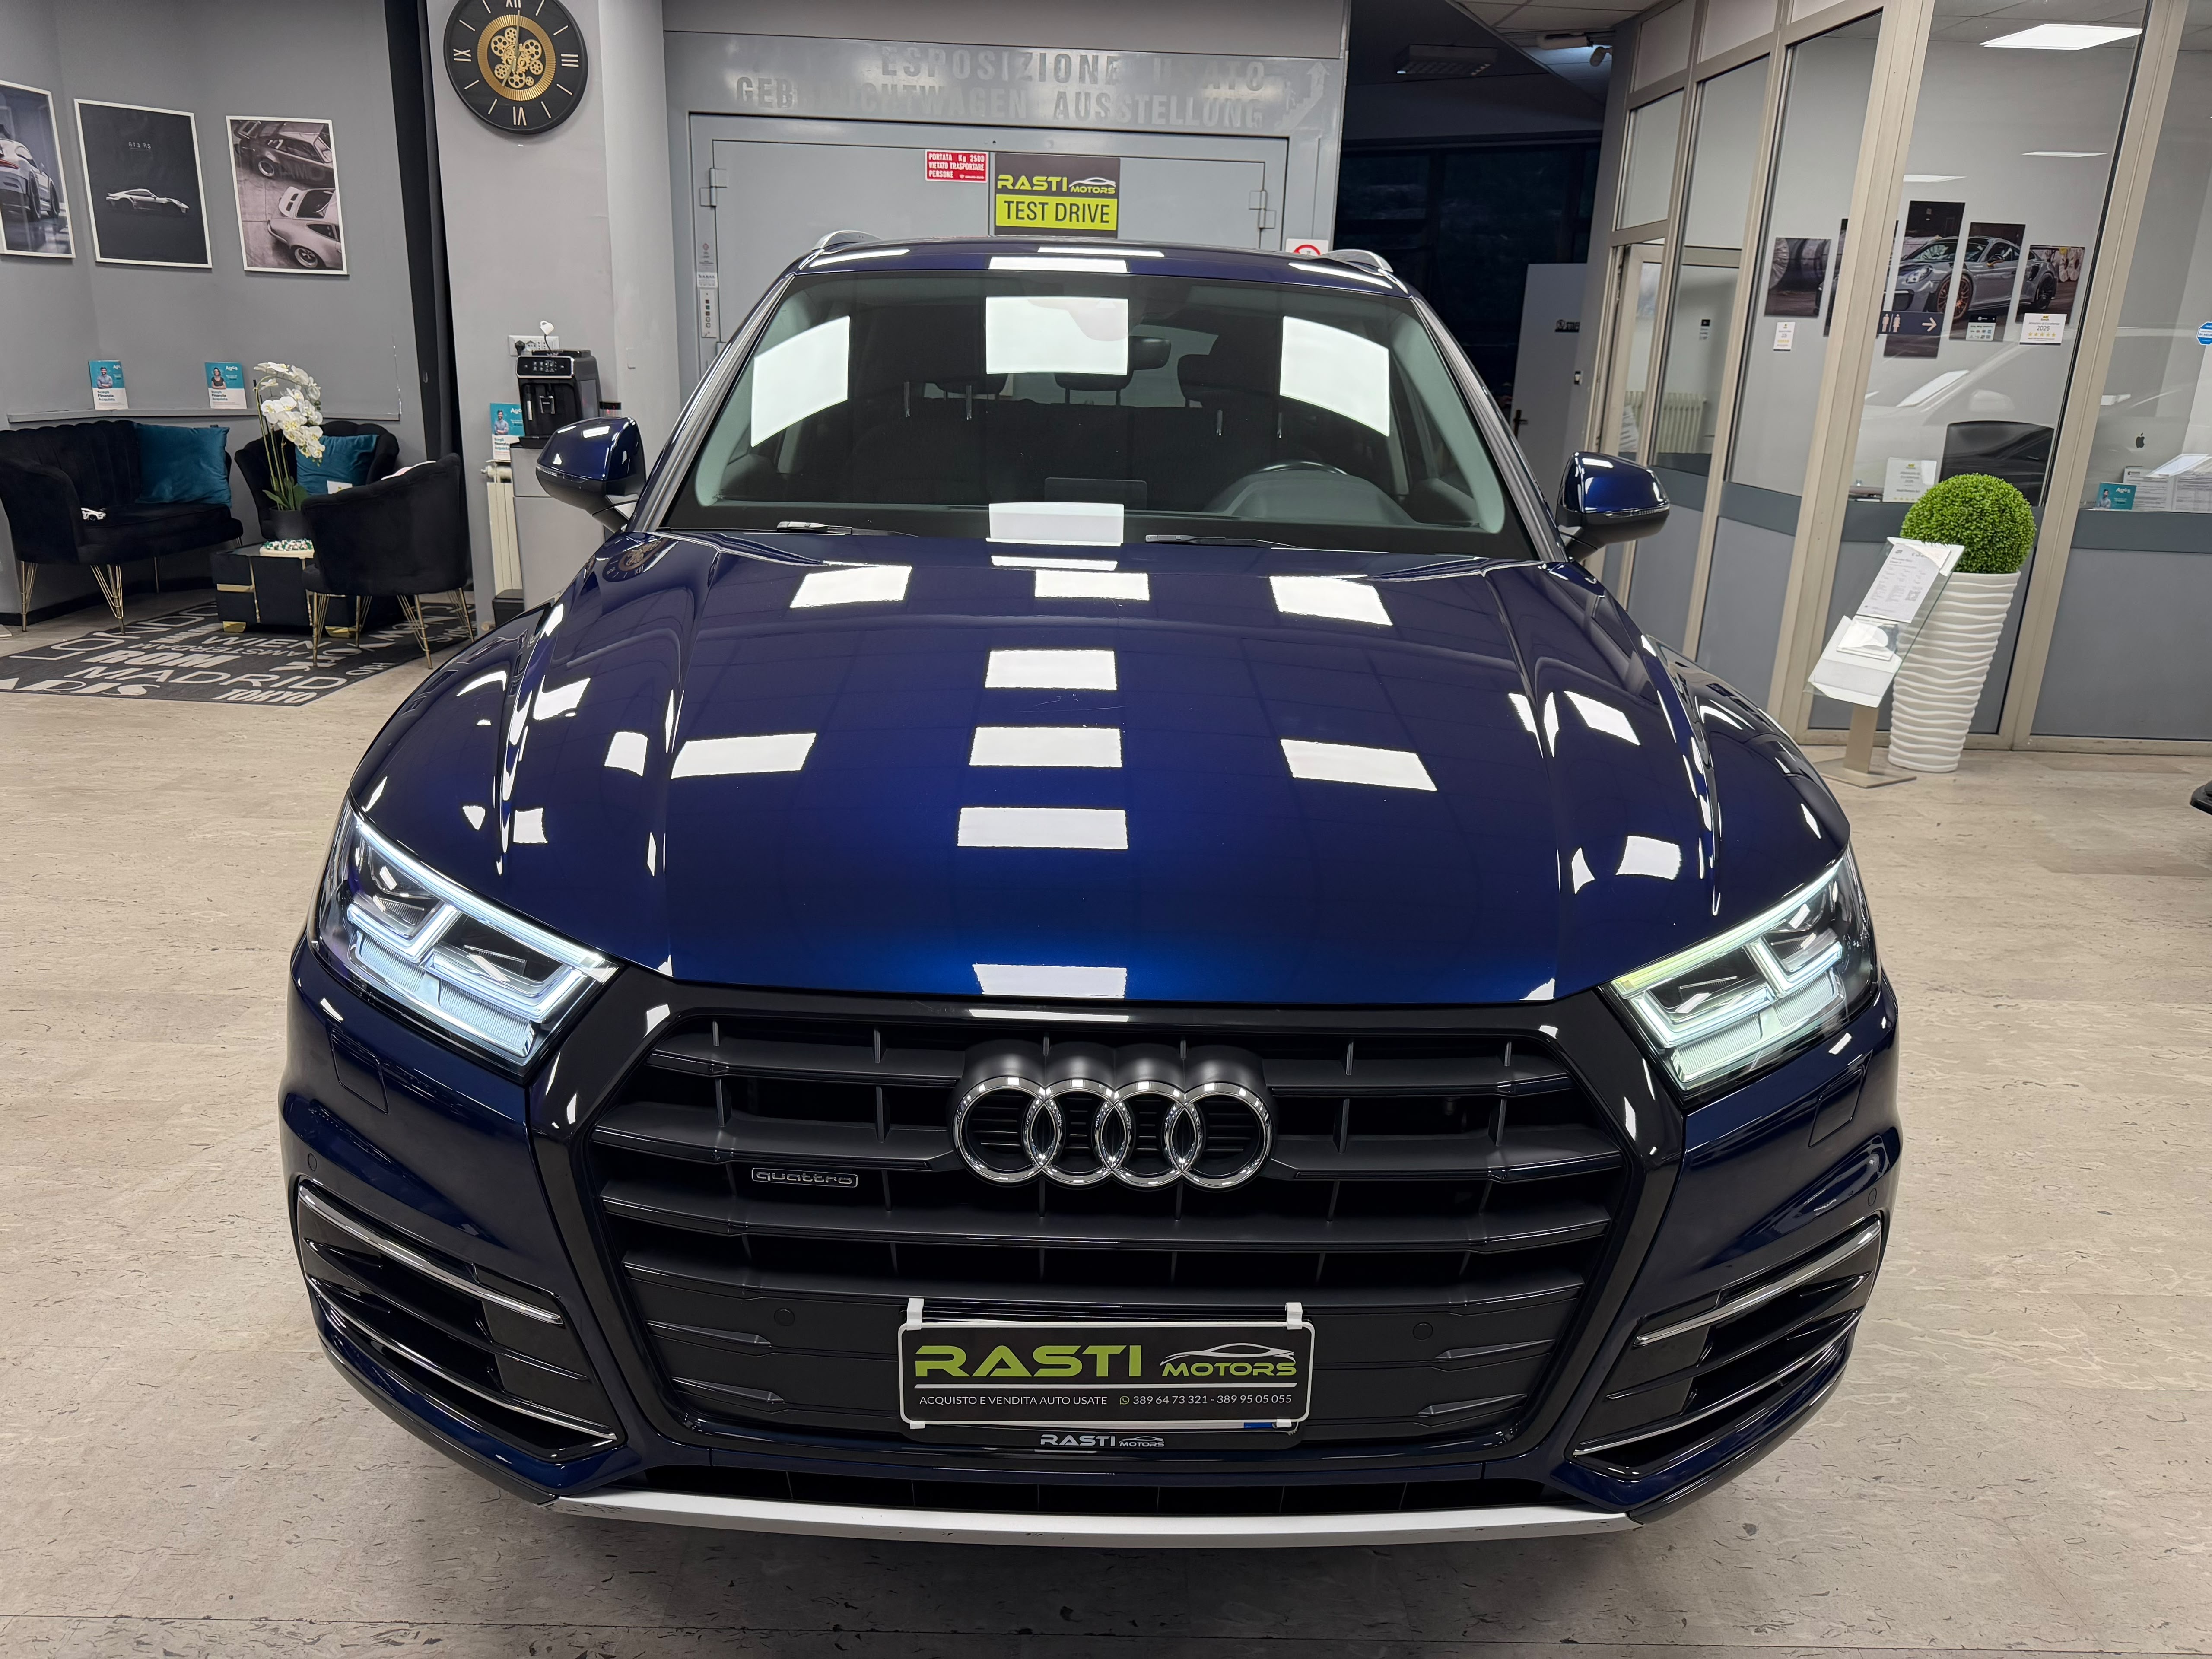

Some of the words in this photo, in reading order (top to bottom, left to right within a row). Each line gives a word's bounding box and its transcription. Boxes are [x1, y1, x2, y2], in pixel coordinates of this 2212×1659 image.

[958, 154, 966, 162] Kg
[950, 162, 985, 171] TRASPORTARE
[997, 175, 1068, 191] RASTI
[1004, 200, 1049, 221] TEST
[1055, 203, 1110, 223] DRIVE
[202, 636, 332, 649] WIEN
[80, 650, 241, 668] ROM
[64, 666, 347, 689] MADRID
[211, 689, 317, 703] TOKYO
[756, 1172, 852, 1184] quattro
[915, 1345, 1141, 1377] RASTI
[1162, 1362, 1297, 1377] MOTORS
[919, 1396, 977, 1406] ACQUISTO
[980, 1396, 986, 1405] E
[988, 1396, 1037, 1405] VENDITA
[1039, 1396, 1071, 1405] AUTO
[1073, 1396, 1107, 1405] USATE
[1133, 1396, 1153, 1405] 389
[1156, 1396, 1169, 1405] 64
[1172, 1396, 1185, 1404] 73
[1188, 1395, 1208, 1404] 321
[1217, 1395, 1237, 1404] 389
[1240, 1395, 1253, 1404] 95
[1255, 1395, 1269, 1404] 05
[1271, 1395, 1292, 1403] 055
[1040, 1434, 1115, 1446] RASTI
